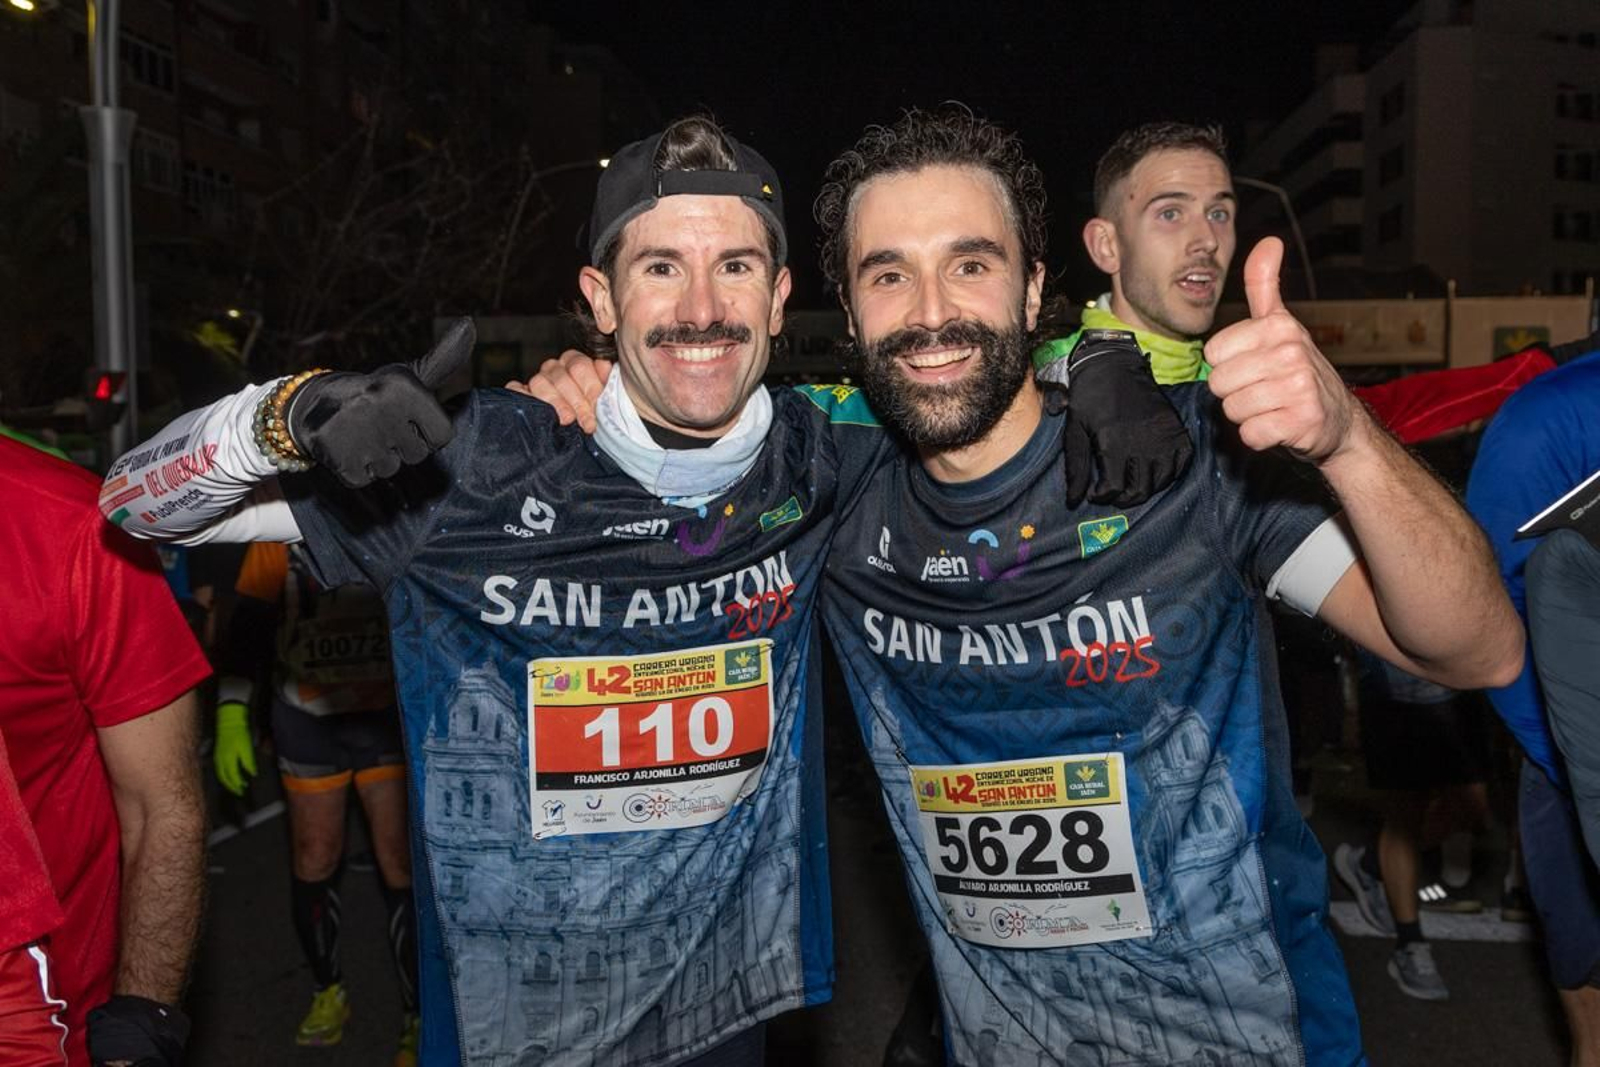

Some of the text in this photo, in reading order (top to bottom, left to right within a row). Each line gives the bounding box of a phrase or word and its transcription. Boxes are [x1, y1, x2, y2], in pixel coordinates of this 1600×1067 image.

[145, 470, 168, 498] DEL
[480, 575, 602, 628] SAN
[863, 591, 1153, 666] SAN ANTÓN
[632, 655, 716, 672] CARRERA URBANA
[1059, 635, 1161, 687] 2025
[586, 664, 632, 696] 42
[632, 676, 665, 693] SAN
[584, 696, 734, 768] 110
[573, 758, 742, 785] FRANCISCO ARJONILLA RODRÍGUEZ
[975, 766, 1054, 781] CARRERA URBANA
[942, 774, 978, 805] 42
[977, 787, 1005, 803] SAN
[935, 810, 1110, 876] 5628
[988, 882, 1033, 894] ARJONILLA
[1034, 881, 1092, 893] RODRÍGUEZ
